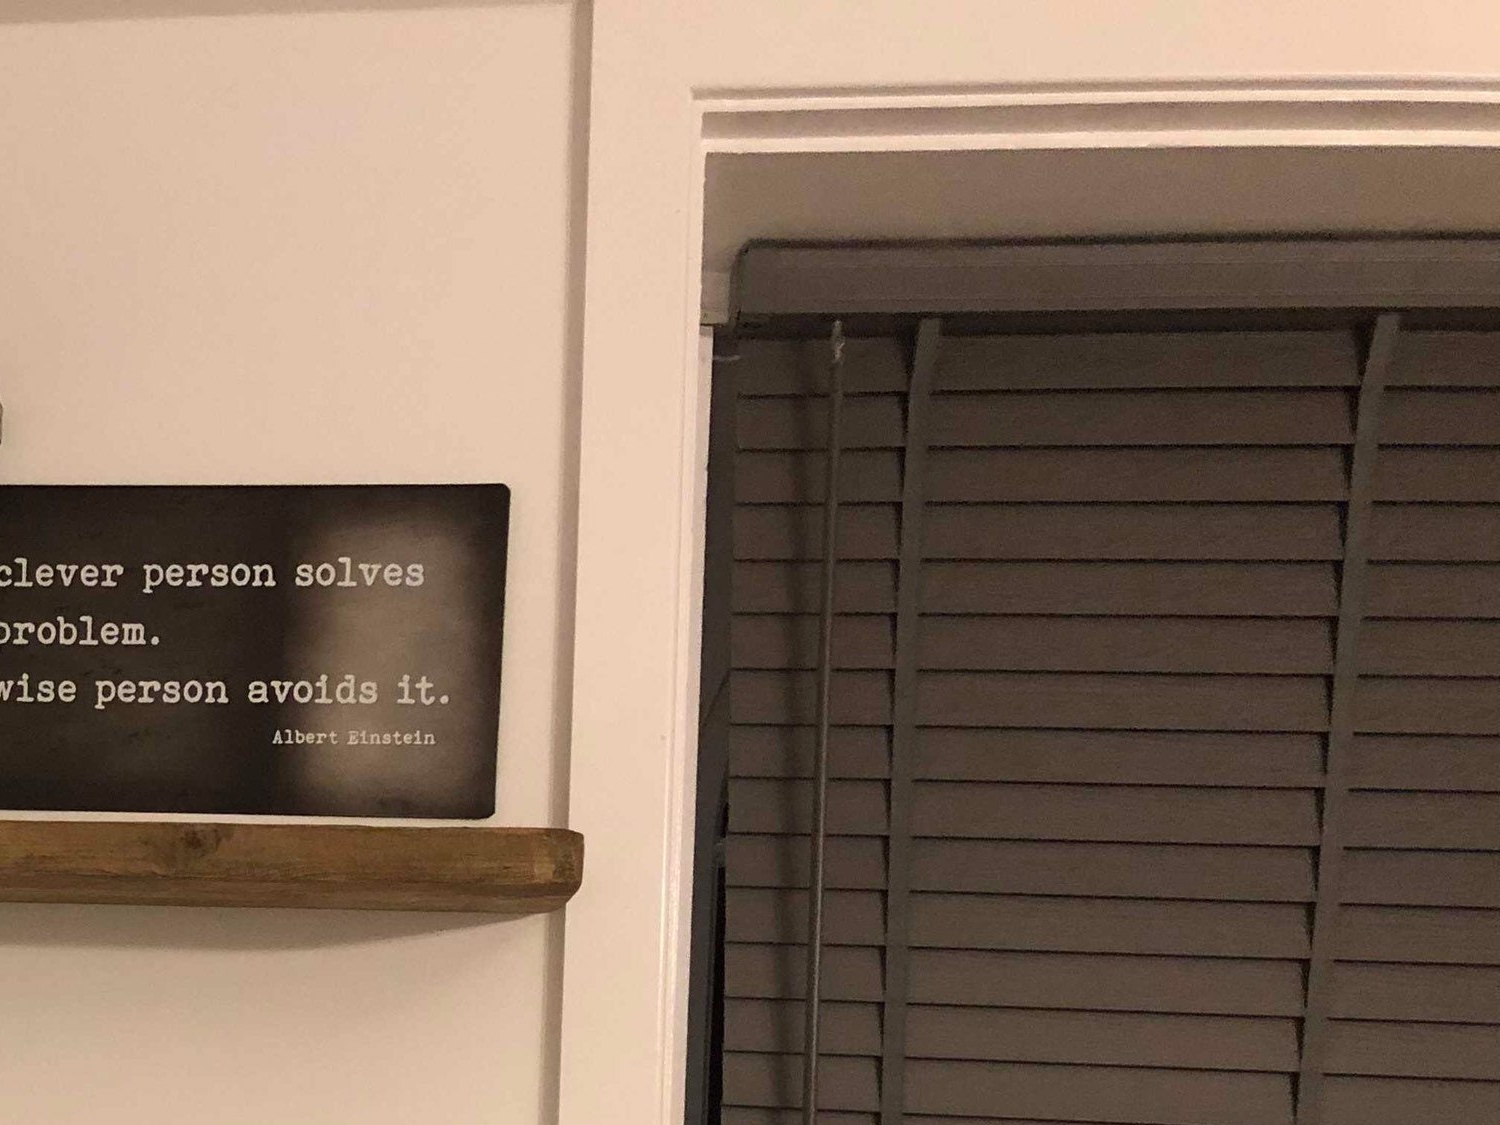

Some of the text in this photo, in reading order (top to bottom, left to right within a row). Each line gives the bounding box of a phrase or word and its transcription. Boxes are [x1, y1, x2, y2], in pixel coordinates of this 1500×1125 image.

[141, 564, 276, 593] person
[294, 556, 425, 587] solves
[94, 680, 229, 710] person
[248, 674, 378, 704] avoids
[397, 675, 451, 704] it.
[272, 729, 436, 746] Albert Einstein
